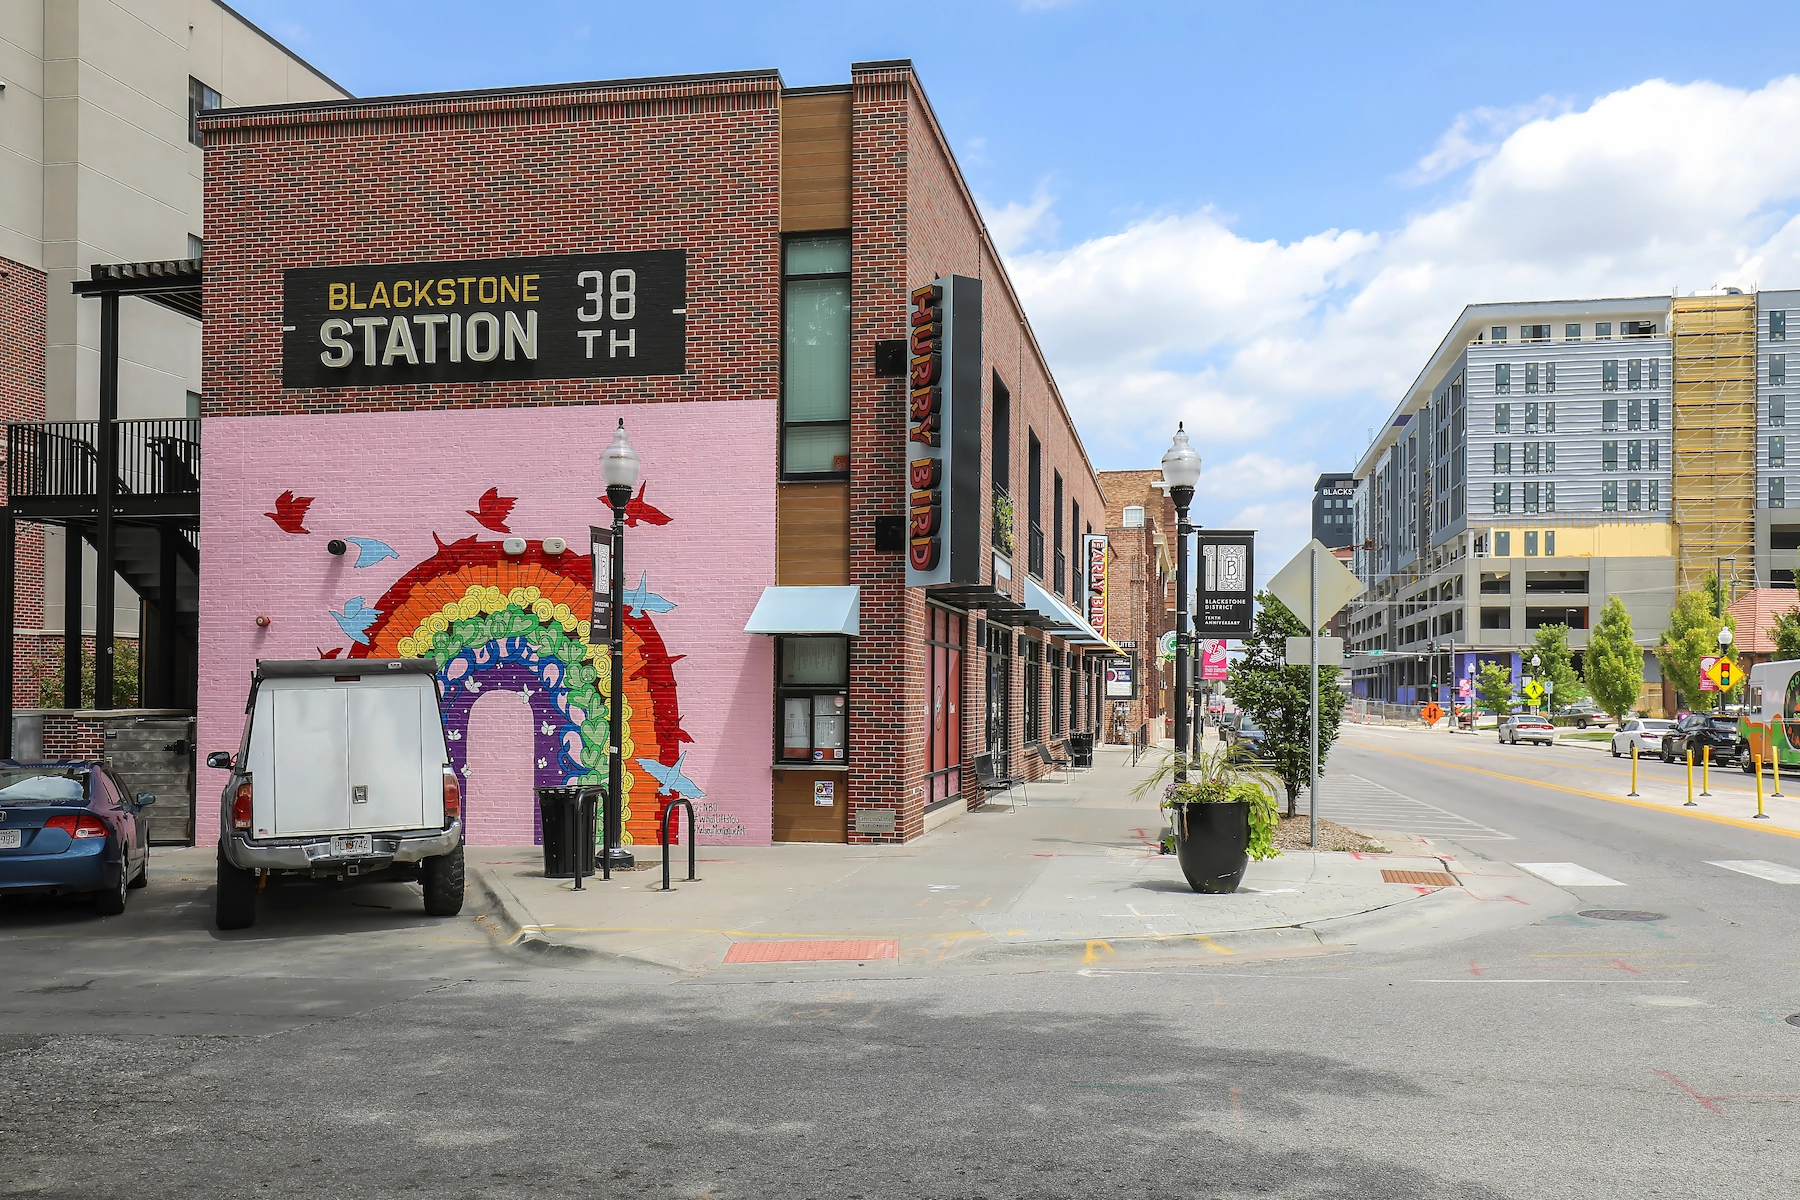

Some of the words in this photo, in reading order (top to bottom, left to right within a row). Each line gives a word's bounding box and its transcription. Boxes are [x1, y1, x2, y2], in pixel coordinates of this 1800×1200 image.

[329, 274, 541, 311] BLACKSTONE
[576, 268, 637, 323] 38
[319, 309, 538, 368] STATION
[577, 328, 636, 359] TH
[909, 284, 942, 448] HURRY
[909, 458, 942, 572] BIRD
[1091, 538, 1106, 594] EARLY
[694, 824, 746, 837] KelseyMontagueArt
